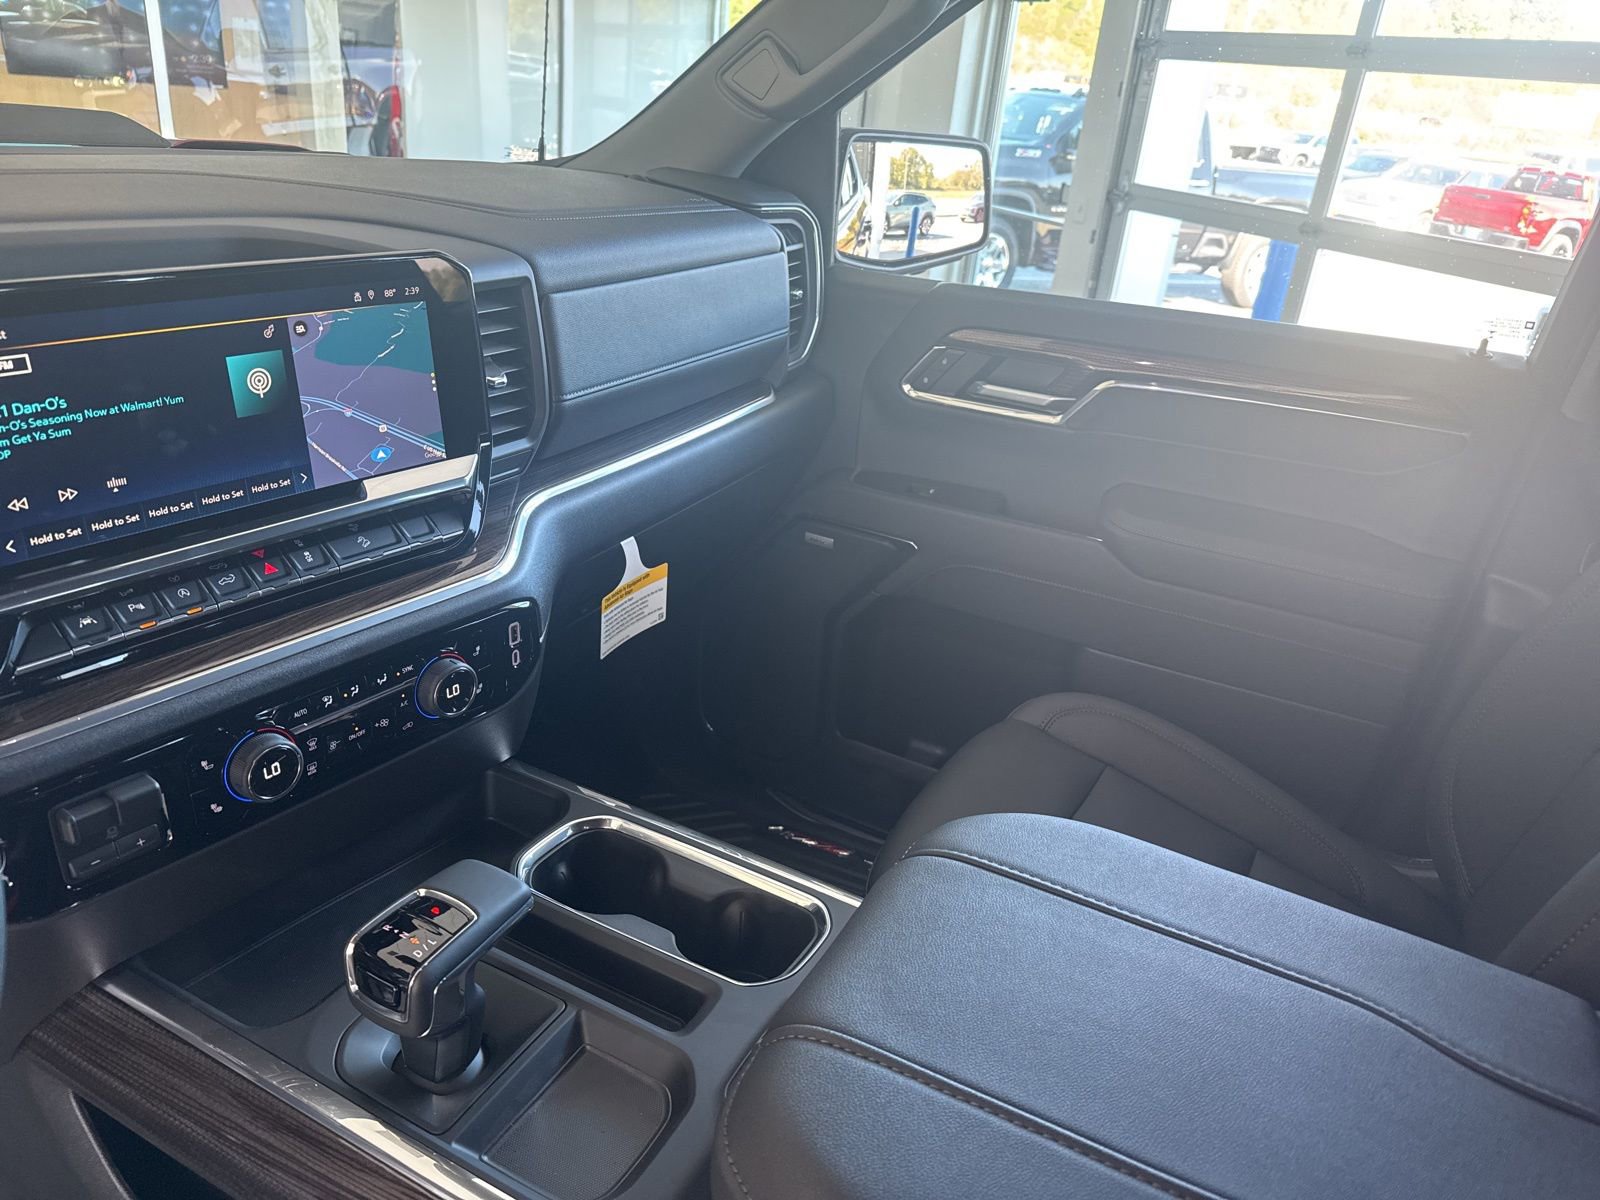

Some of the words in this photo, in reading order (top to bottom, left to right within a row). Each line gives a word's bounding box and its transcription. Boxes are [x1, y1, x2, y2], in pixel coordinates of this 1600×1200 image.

[404, 286, 420, 296] 2:39
[12, 396, 68, 416] Dan-O's
[28, 411, 83, 429] Seasoning
[84, 407, 108, 419] Now
[109, 405, 119, 415] at
[120, 397, 163, 413] Walmart!
[163, 395, 185, 406] Yum
[12, 433, 32, 446] Get
[32, 430, 47, 442] Ya
[48, 427, 72, 439] Sum
[251, 483, 269, 494] Hold
[270, 481, 278, 489] to
[279, 478, 291, 487] Set
[201, 494, 220, 505] Hold
[221, 492, 231, 501] to
[231, 489, 245, 499] Set
[148, 506, 169, 518] Hold
[170, 504, 179, 513] to
[180, 501, 194, 511] Set
[91, 520, 113, 532] Hold
[114, 518, 125, 527] to
[126, 513, 140, 524] Set
[29, 534, 54, 546] Hold
[54, 532, 65, 541] to
[67, 527, 83, 538] Set
[401, 664, 414, 674] SYNC
[446, 683, 460, 699] LO
[293, 707, 308, 718] AUTO
[348, 728, 366, 741] ON/OFF
[263, 761, 281, 780] LO
